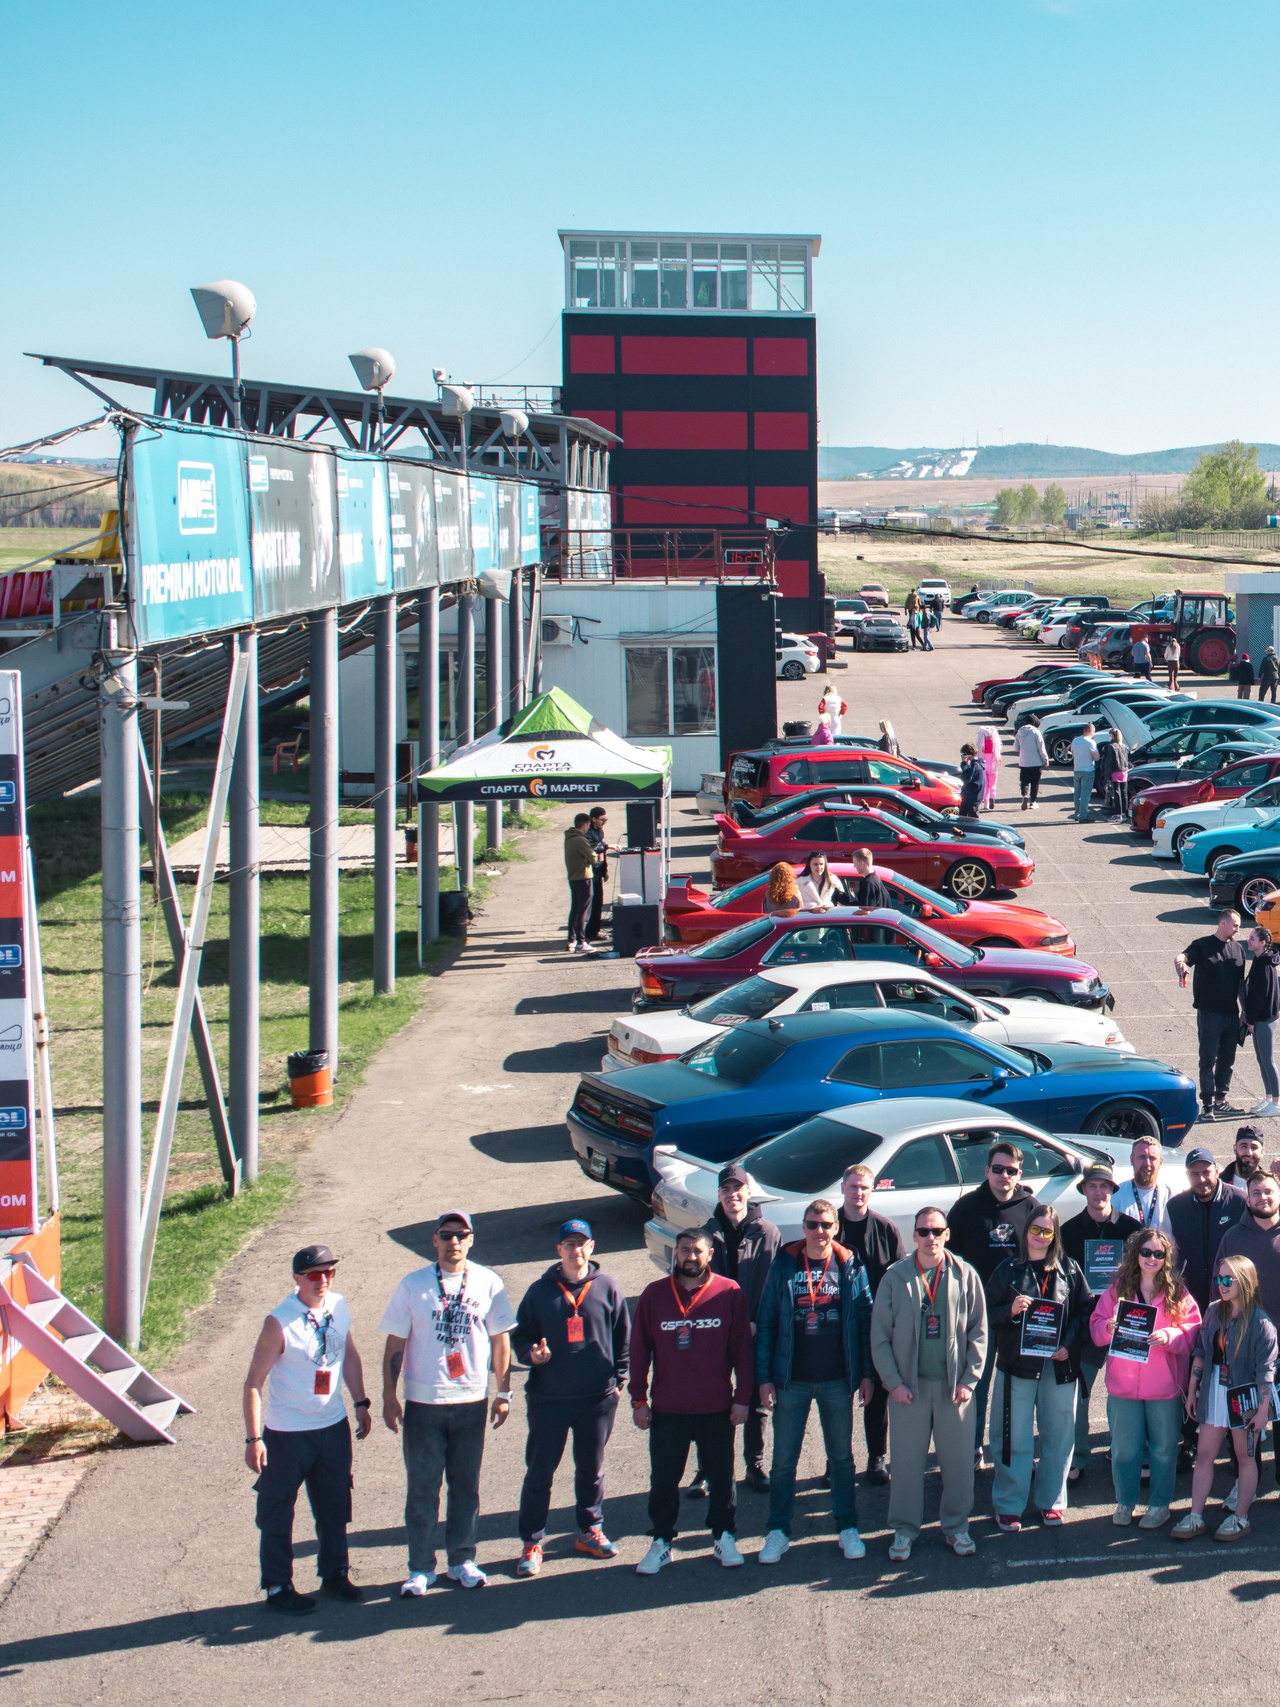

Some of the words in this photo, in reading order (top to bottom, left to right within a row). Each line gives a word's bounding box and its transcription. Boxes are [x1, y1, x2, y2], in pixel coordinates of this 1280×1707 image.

[142, 562, 193, 605] PREMIUM
[195, 559, 228, 598] MOTOR
[229, 557, 243, 593] OIL
[481, 784, 527, 794] СПАРТА
[550, 783, 600, 793] МАРКЕТ
[877, 1179, 895, 1187] JST
[1096, 1245, 1114, 1253] JST
[1037, 1305, 1055, 1313] JST
[1128, 1308, 1148, 1317] JST
